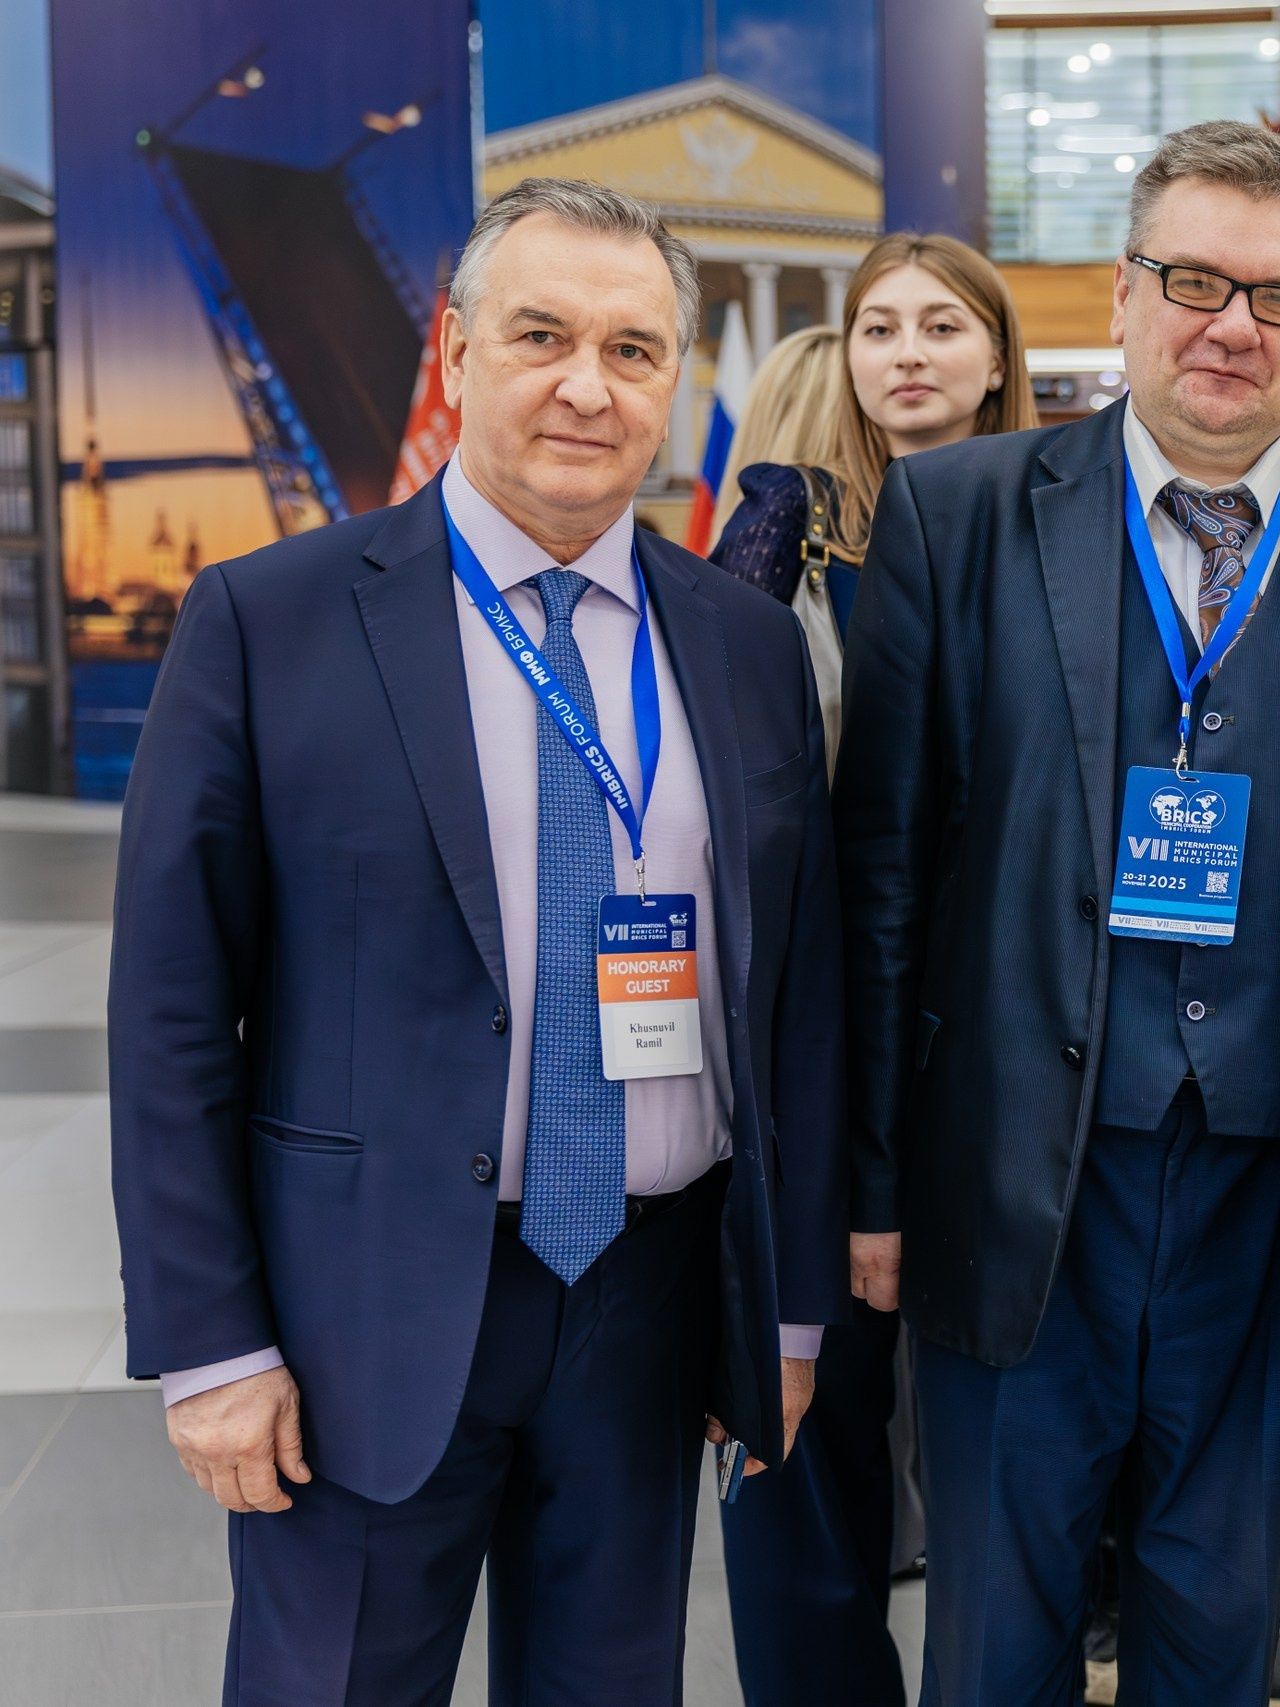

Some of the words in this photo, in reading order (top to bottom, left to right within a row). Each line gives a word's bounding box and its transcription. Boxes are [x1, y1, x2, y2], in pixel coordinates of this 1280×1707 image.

[487, 601, 526, 650] БРИКС
[547, 691, 591, 746] FORUM
[585, 745, 628, 810] IMBRICS
[1161, 809, 1212, 825] BRICS
[1128, 836, 1169, 861] VII
[1174, 848, 1238, 859] MUNICIPAL
[1175, 841, 1239, 852] INTERNATIONAL
[1173, 855, 1201, 865] BRICS
[1205, 858, 1238, 867] FORUM
[1122, 872, 1147, 882] 20-21
[1148, 875, 1187, 890] 2025
[603, 924, 629, 942] VII
[607, 959, 687, 975] HONORARY
[626, 979, 670, 994] GUEST
[636, 1038, 662, 1049] Ramil
